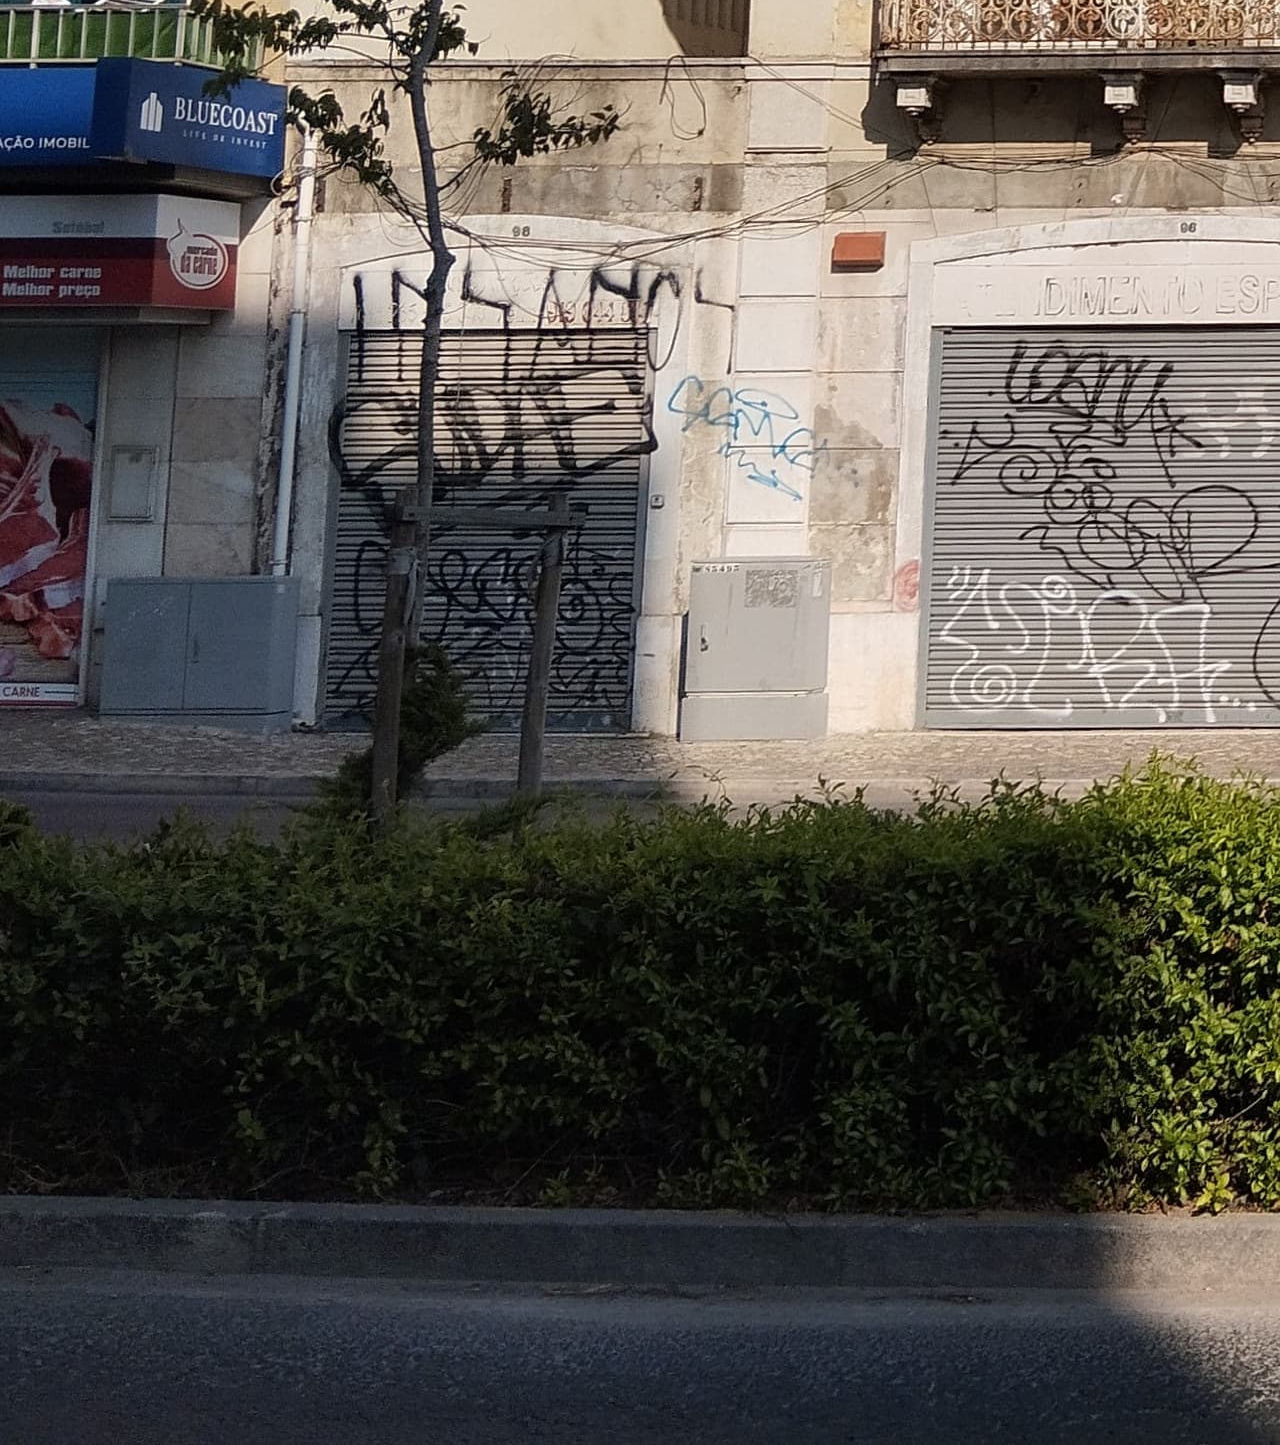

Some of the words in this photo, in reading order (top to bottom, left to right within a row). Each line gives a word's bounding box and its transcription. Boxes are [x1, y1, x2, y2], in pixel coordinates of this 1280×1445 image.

[174, 96, 278, 136] BLUECOAST
[39, 137, 91, 149] IMOBIL
[512, 225, 531, 237] 98
[3, 265, 54, 279] Melhor
[59, 266, 102, 279] carne
[2, 283, 54, 297] Melhor
[58, 284, 101, 299] preço
[3, 686, 41, 698] CARNE
